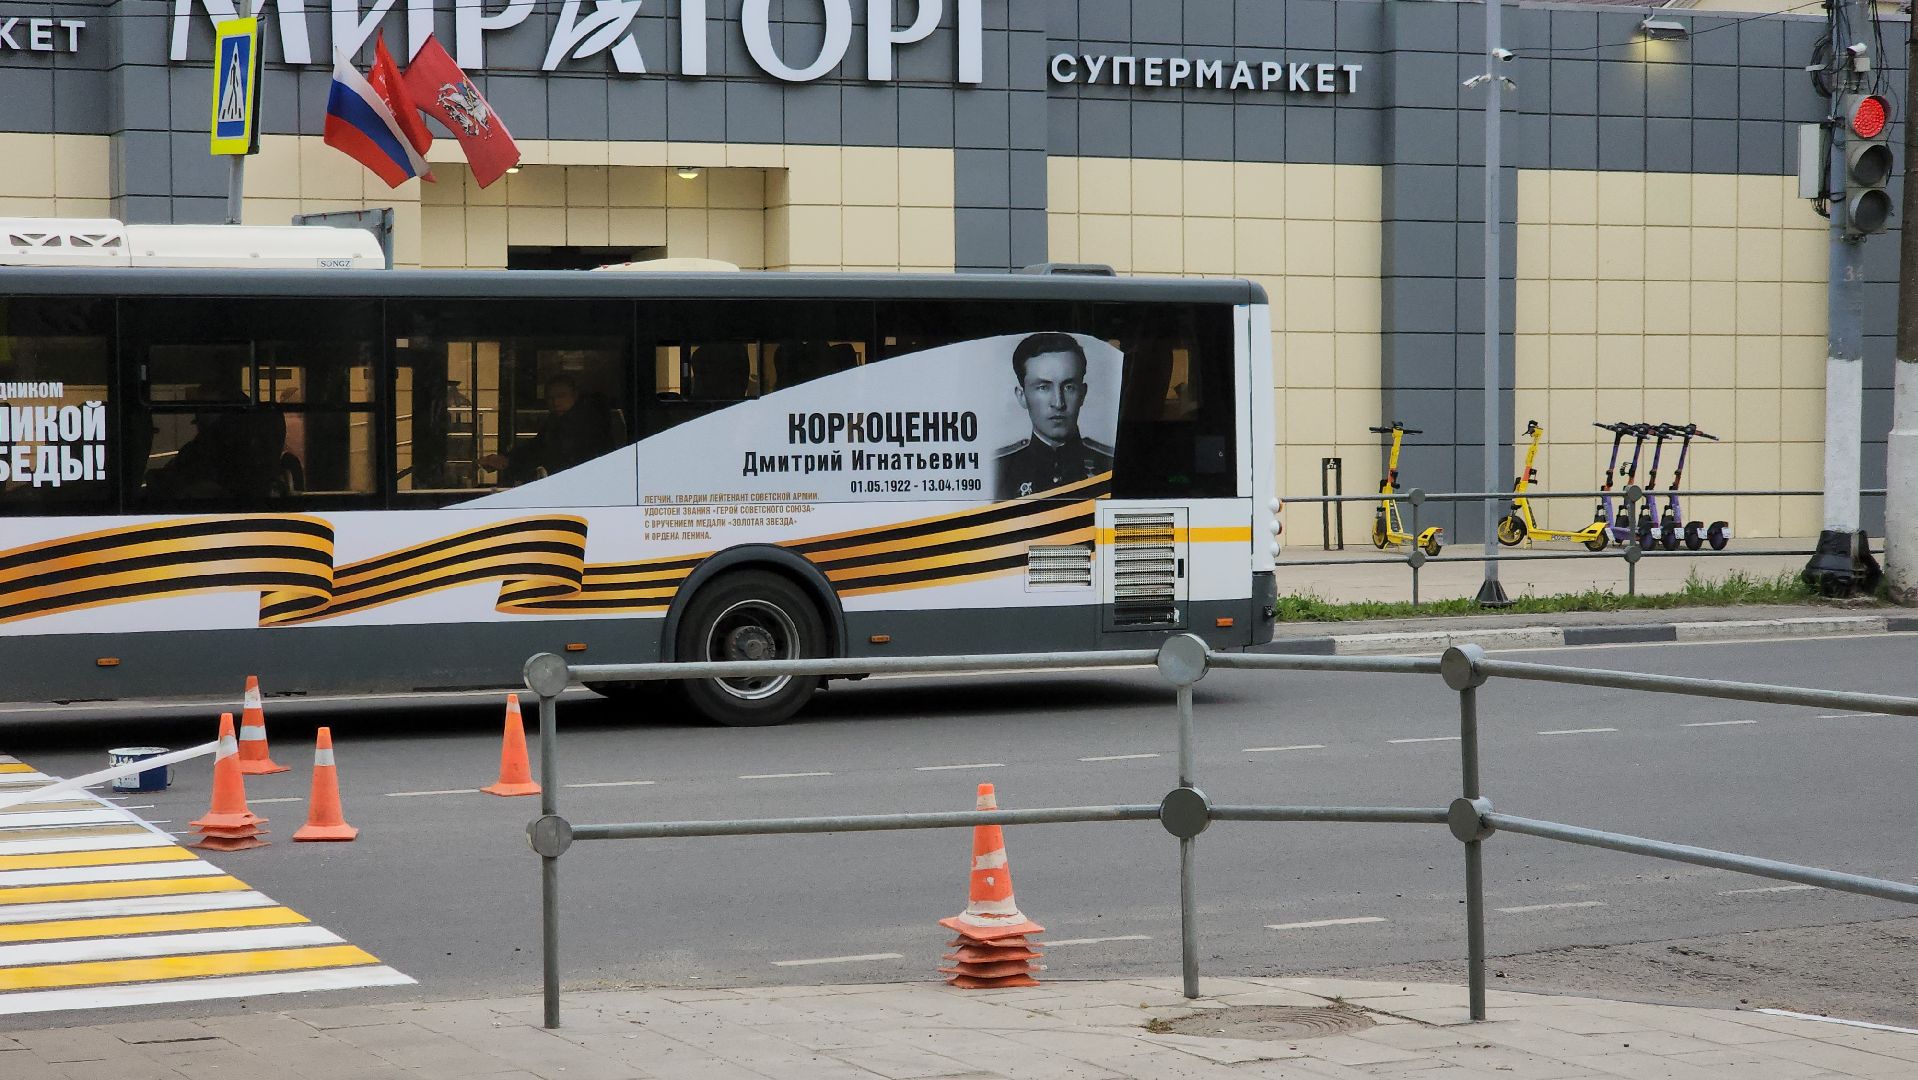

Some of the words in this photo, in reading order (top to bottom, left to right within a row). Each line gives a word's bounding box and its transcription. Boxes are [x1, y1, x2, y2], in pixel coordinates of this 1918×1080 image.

[1051, 53, 1363, 93] СУПЕРМАРКЕТ
[320, 260, 351, 268] SONGZ
[788, 411, 978, 447] КОРКОЦЕНКО
[742, 450, 843, 476] Дмитрий
[851, 449, 979, 471] Игнатьевич
[850, 480, 911, 493] 01.05.1922
[922, 479, 981, 492] 13.04.1990
